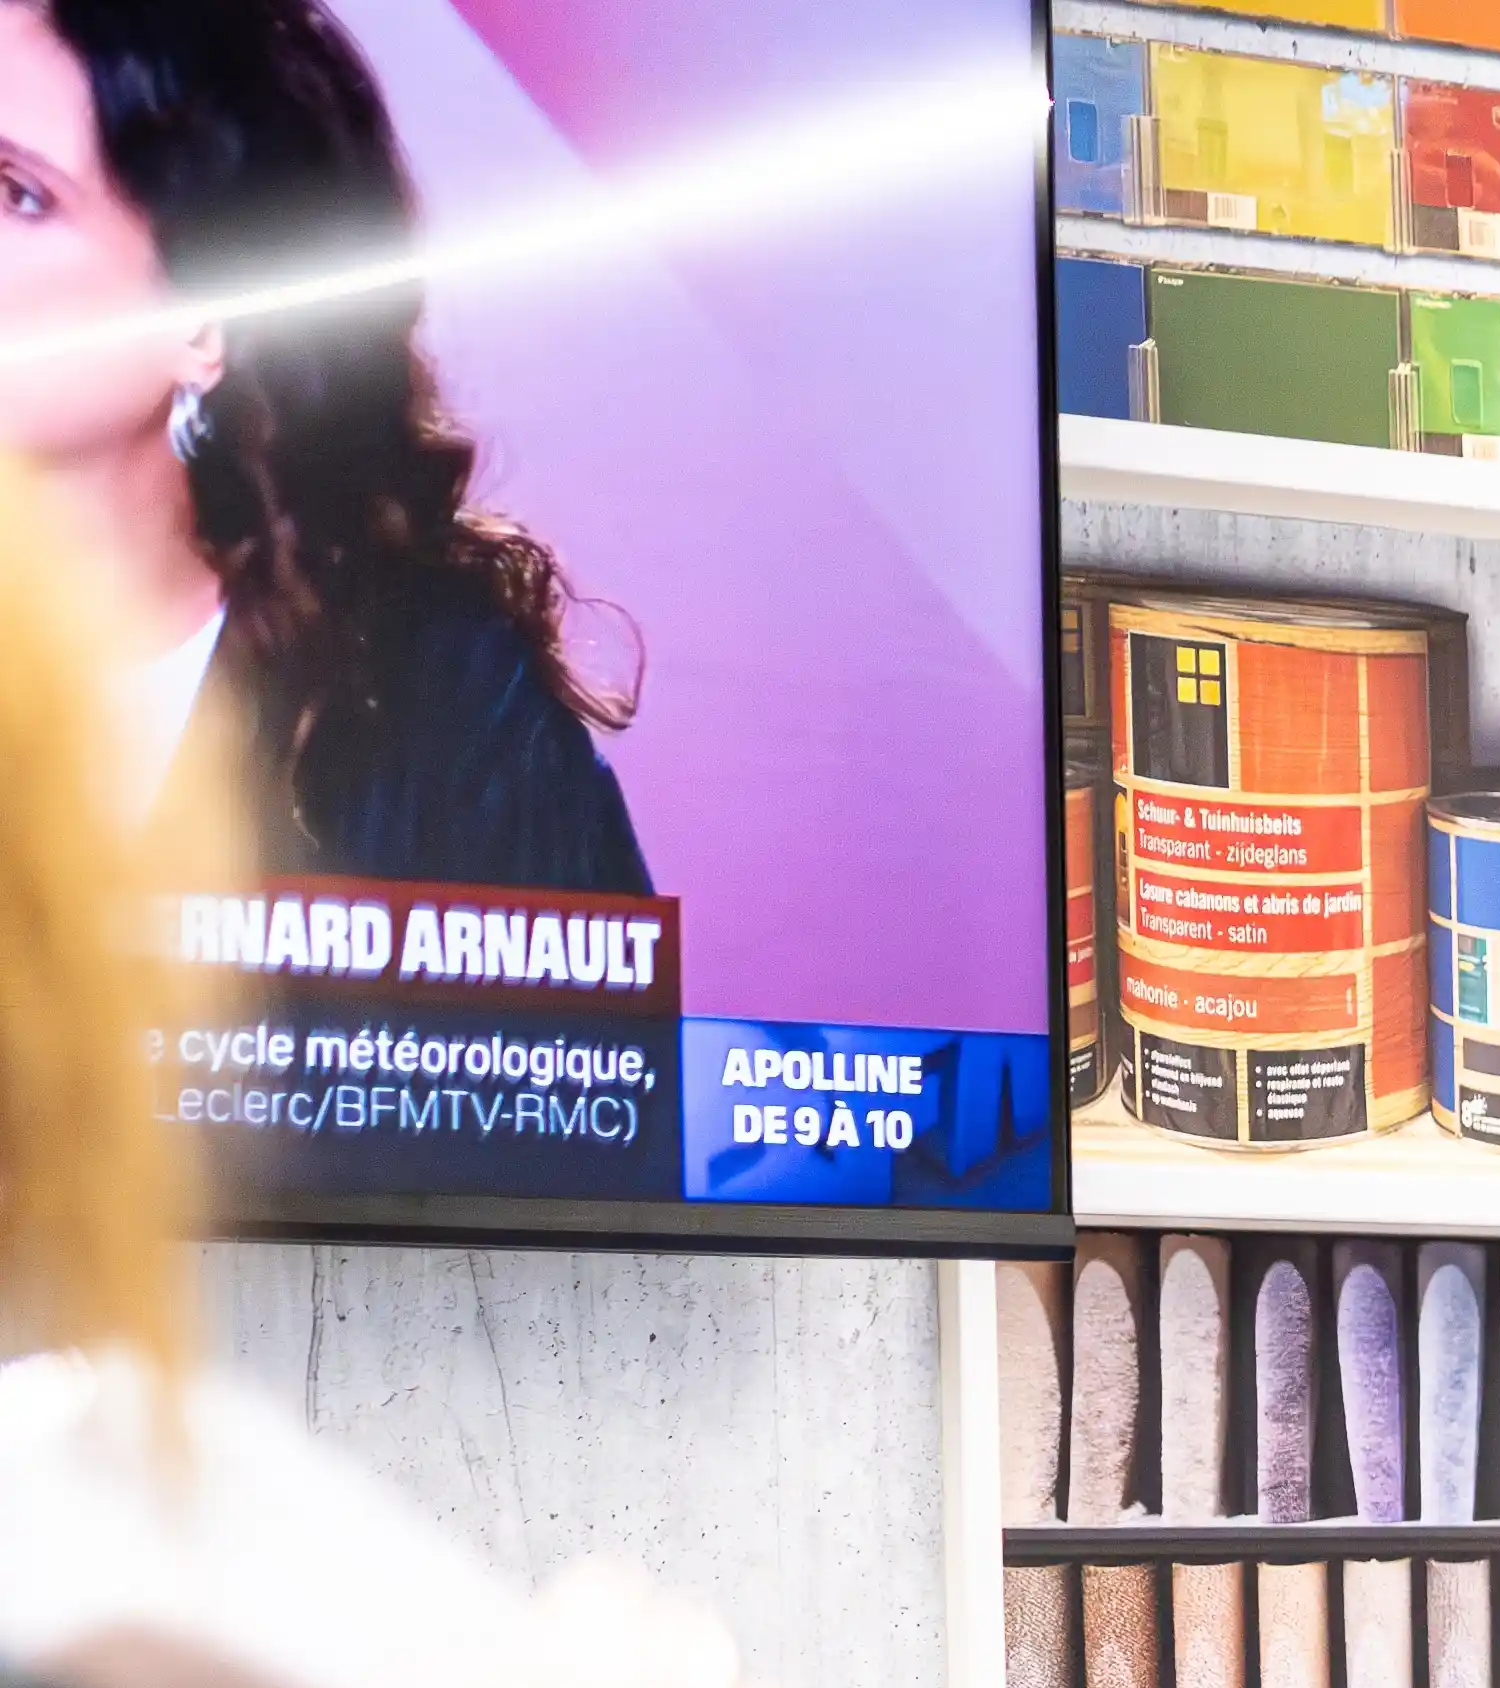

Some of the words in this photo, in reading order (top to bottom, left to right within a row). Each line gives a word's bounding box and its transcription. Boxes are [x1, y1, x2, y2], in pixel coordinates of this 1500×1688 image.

[1138, 799, 1181, 825] Schuur-
[1184, 807, 1196, 828] &
[1199, 809, 1302, 836] Tuinhuisbeits
[1138, 828, 1211, 861] Transparant
[1227, 842, 1308, 869] zijdeglans
[1140, 906, 1213, 942] Transparent
[1227, 921, 1268, 945] satin
[1175, 890, 1240, 915] cabanons
[1244, 895, 1259, 915] et
[1262, 892, 1299, 916] abris
[1303, 894, 1321, 916] de
[1324, 890, 1362, 920] jardin
[160, 894, 392, 974] RNARD
[400, 907, 662, 985] ARNAULT
[1126, 976, 1179, 1010] mahonie
[1195, 994, 1258, 1023] acajou
[178, 1022, 295, 1073] cycle
[305, 1027, 656, 1091] météorologique,
[721, 1047, 924, 1095] APOLLINE
[153, 1080, 639, 1144] Leclerc/BFMTV-RMC)
[733, 1104, 788, 1144] DE
[793, 1106, 821, 1147] 9
[825, 1099, 861, 1148] À
[865, 1109, 914, 1150] 10
